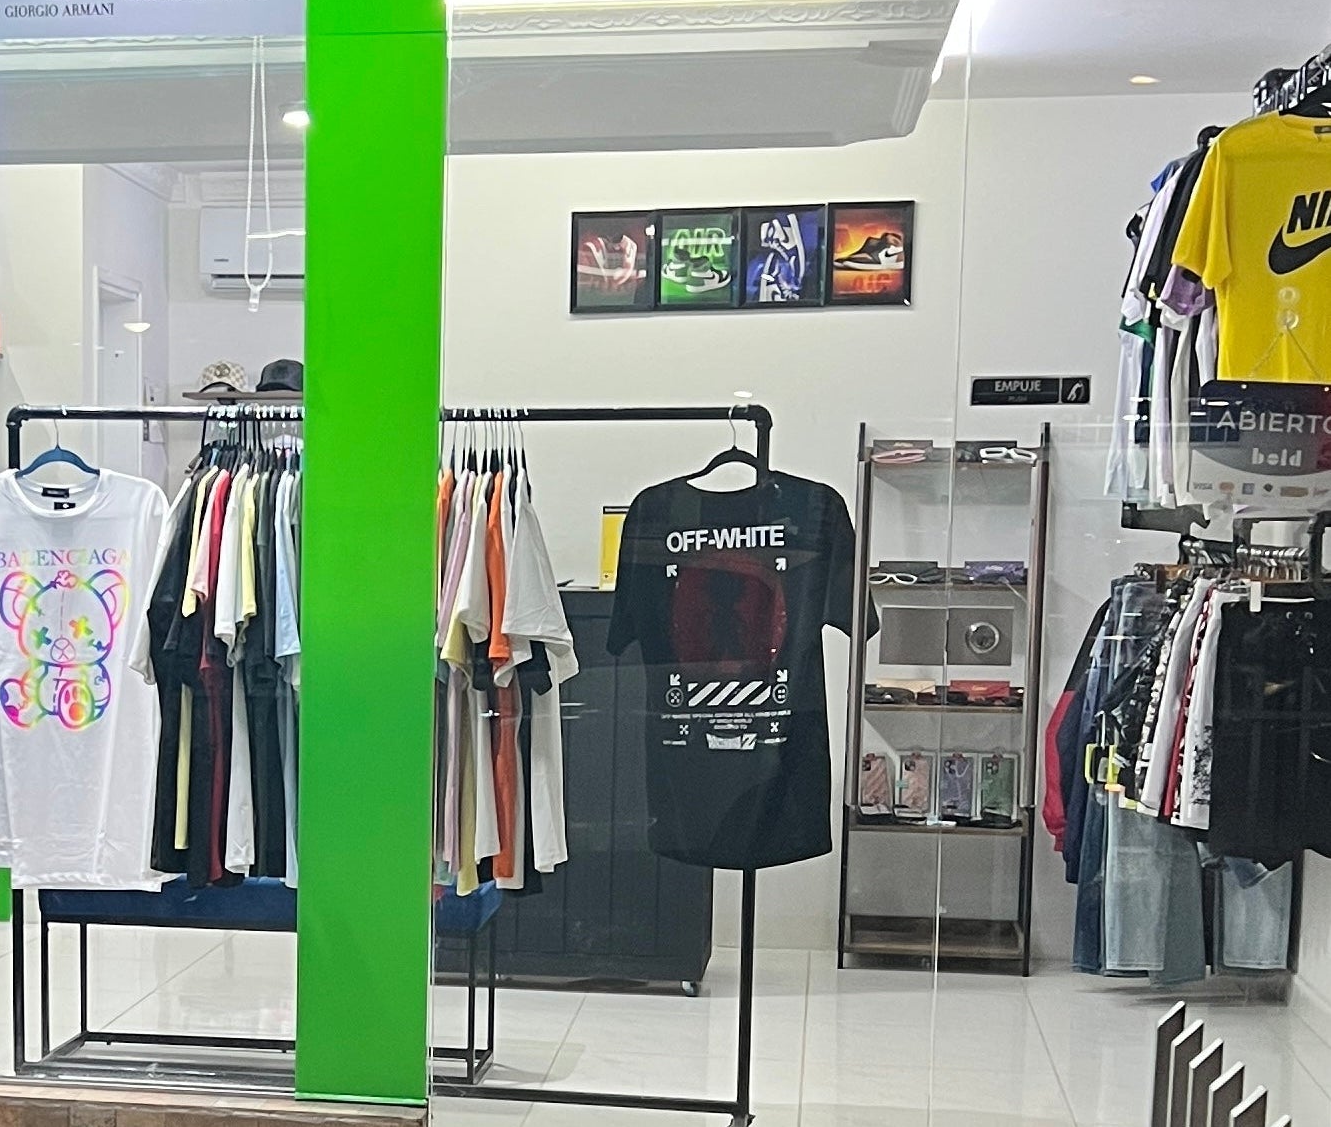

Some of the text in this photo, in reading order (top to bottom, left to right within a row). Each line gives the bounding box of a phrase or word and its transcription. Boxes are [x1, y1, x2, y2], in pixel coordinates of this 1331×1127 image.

[5, 3, 114, 17] GIORGIO ARMANI
[995, 380, 1042, 392] EMPUJE
[1252, 447, 1302, 466] bold
[666, 525, 785, 553] OFF-WHITE
